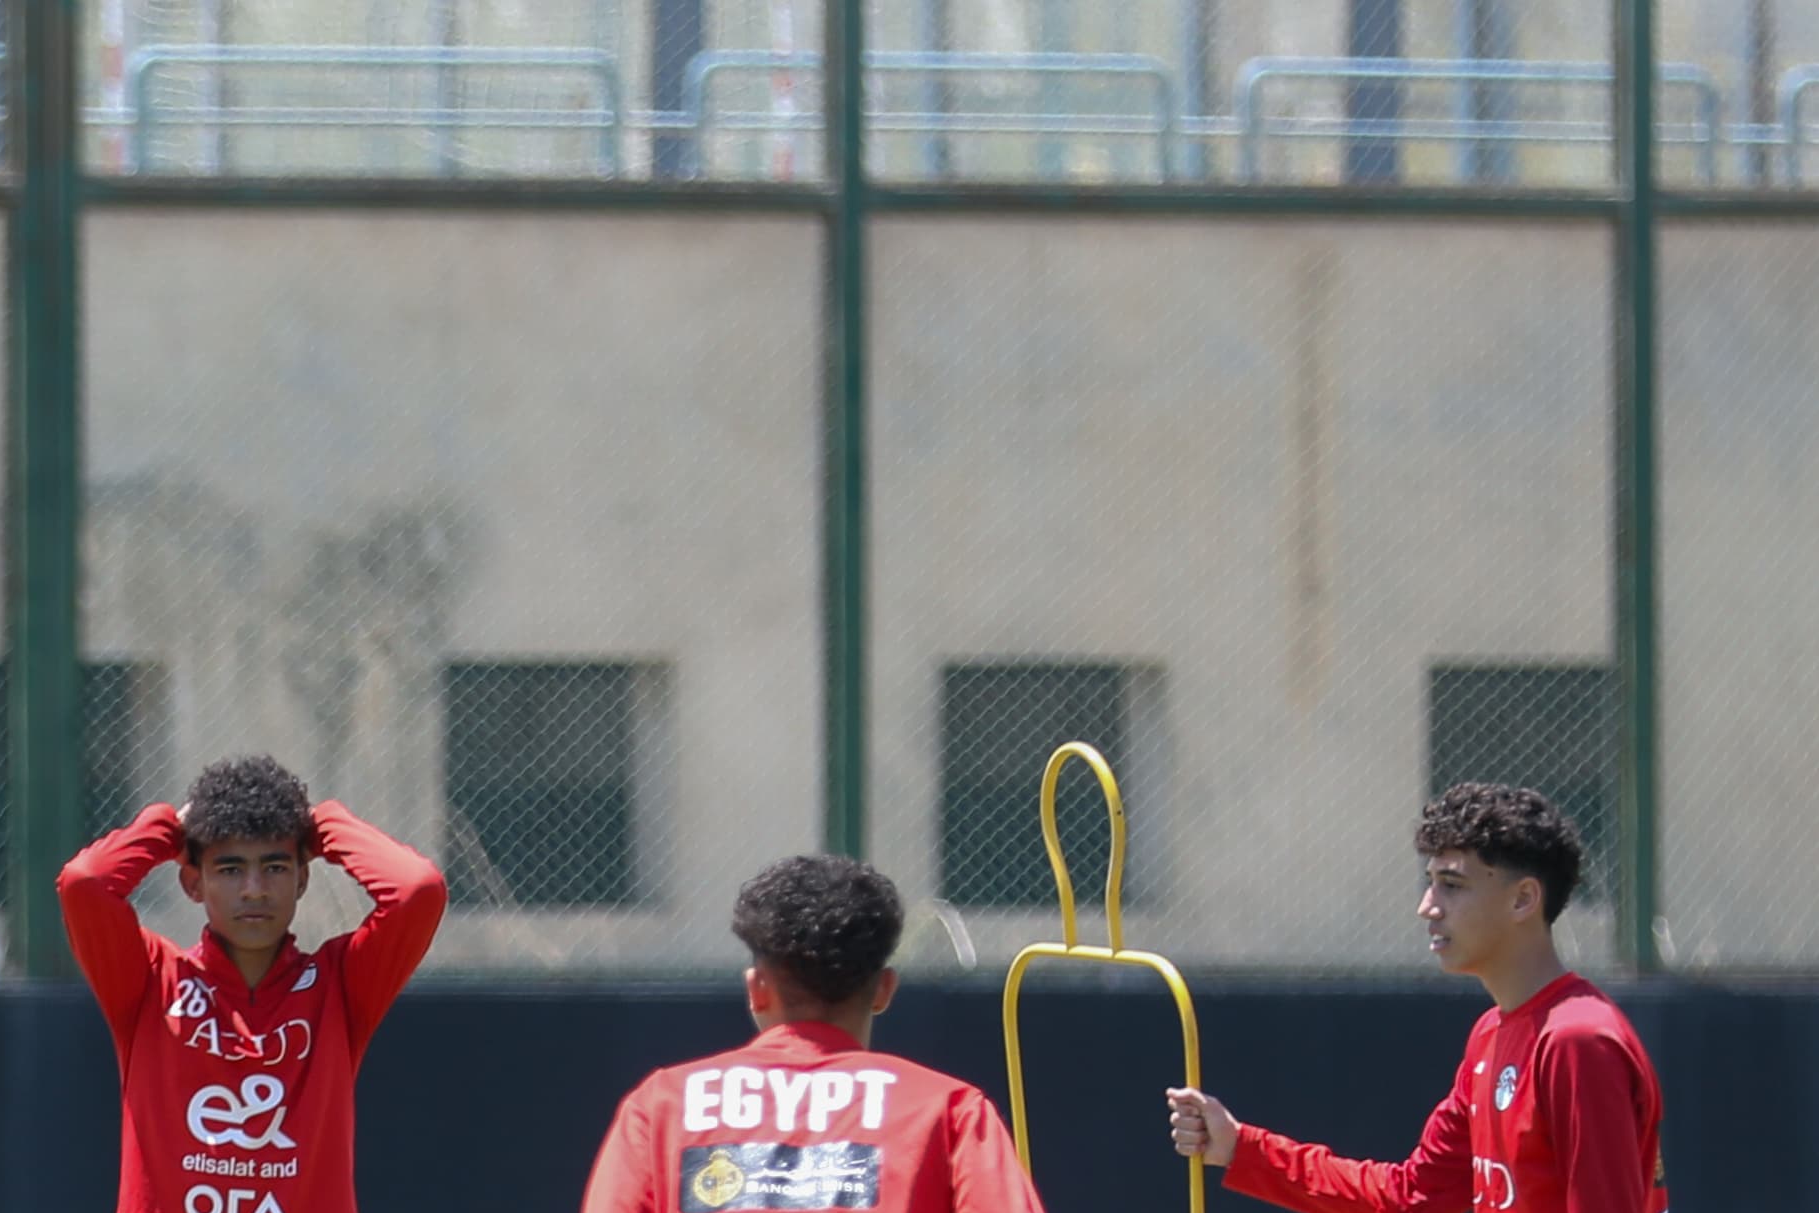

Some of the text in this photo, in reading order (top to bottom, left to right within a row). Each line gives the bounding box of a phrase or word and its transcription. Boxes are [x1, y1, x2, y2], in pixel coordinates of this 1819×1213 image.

[684, 1066, 896, 1132] EGYPT
[182, 1153, 298, 1178] etisalat and
